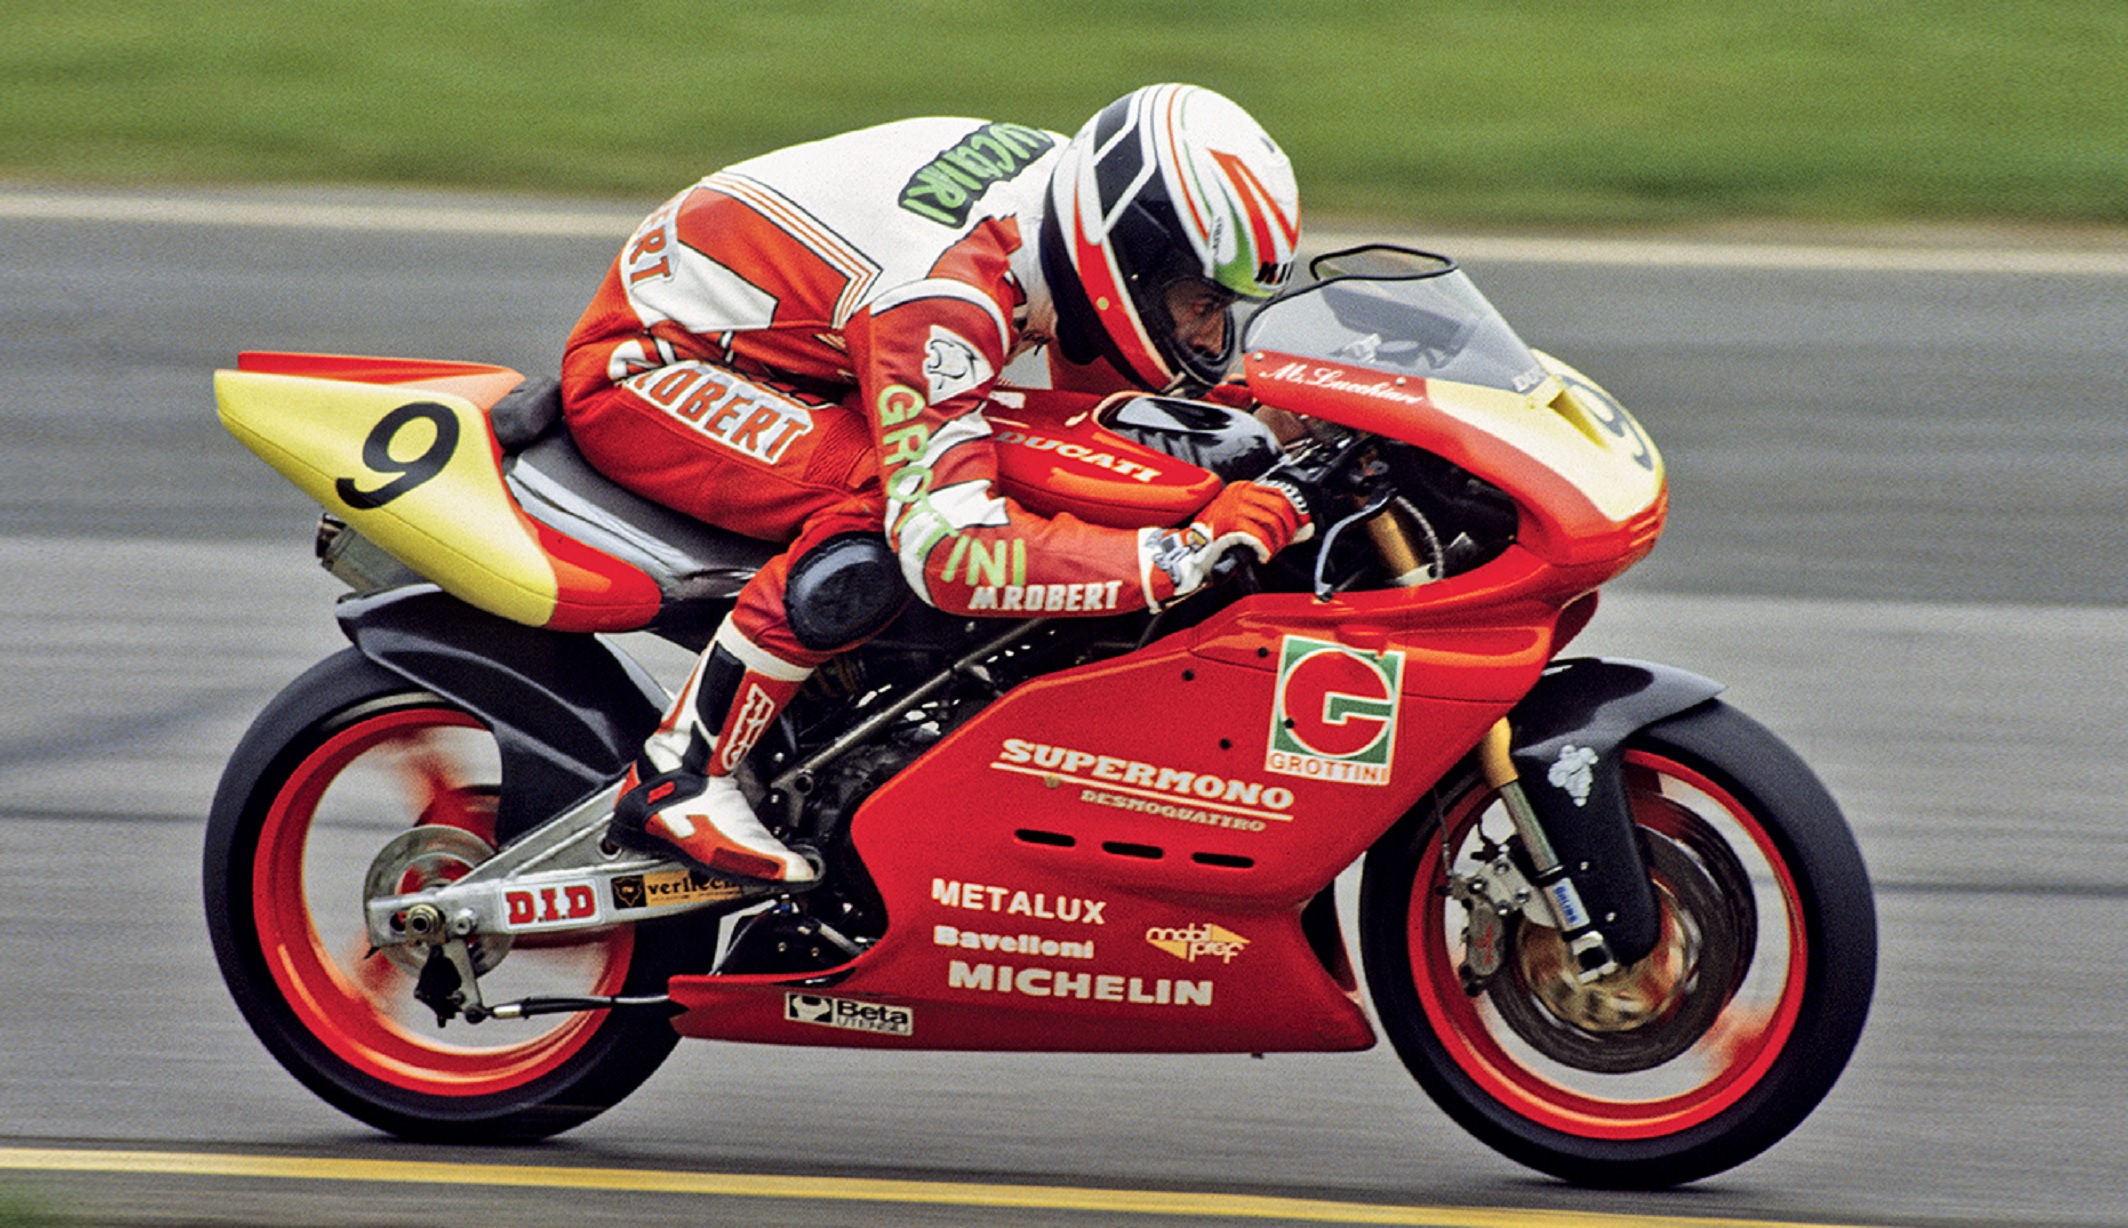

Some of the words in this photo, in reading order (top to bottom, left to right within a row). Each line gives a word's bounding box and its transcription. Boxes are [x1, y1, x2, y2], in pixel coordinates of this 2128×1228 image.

[335, 400, 461, 511] 9
[994, 431, 1163, 483] DUCATI
[878, 384, 1026, 588] GROTTINI
[1000, 738, 1295, 810] SUPERMONO
[1269, 751, 1389, 784] GROTTINI
[1081, 789, 1267, 832] DESMOQUATTRO
[505, 885, 596, 925] D.I.D
[932, 878, 1106, 924] METALUX
[933, 925, 1095, 959] Bavelloni
[948, 960, 1213, 1006] MICHELIN
[837, 1000, 908, 1024] Beta
